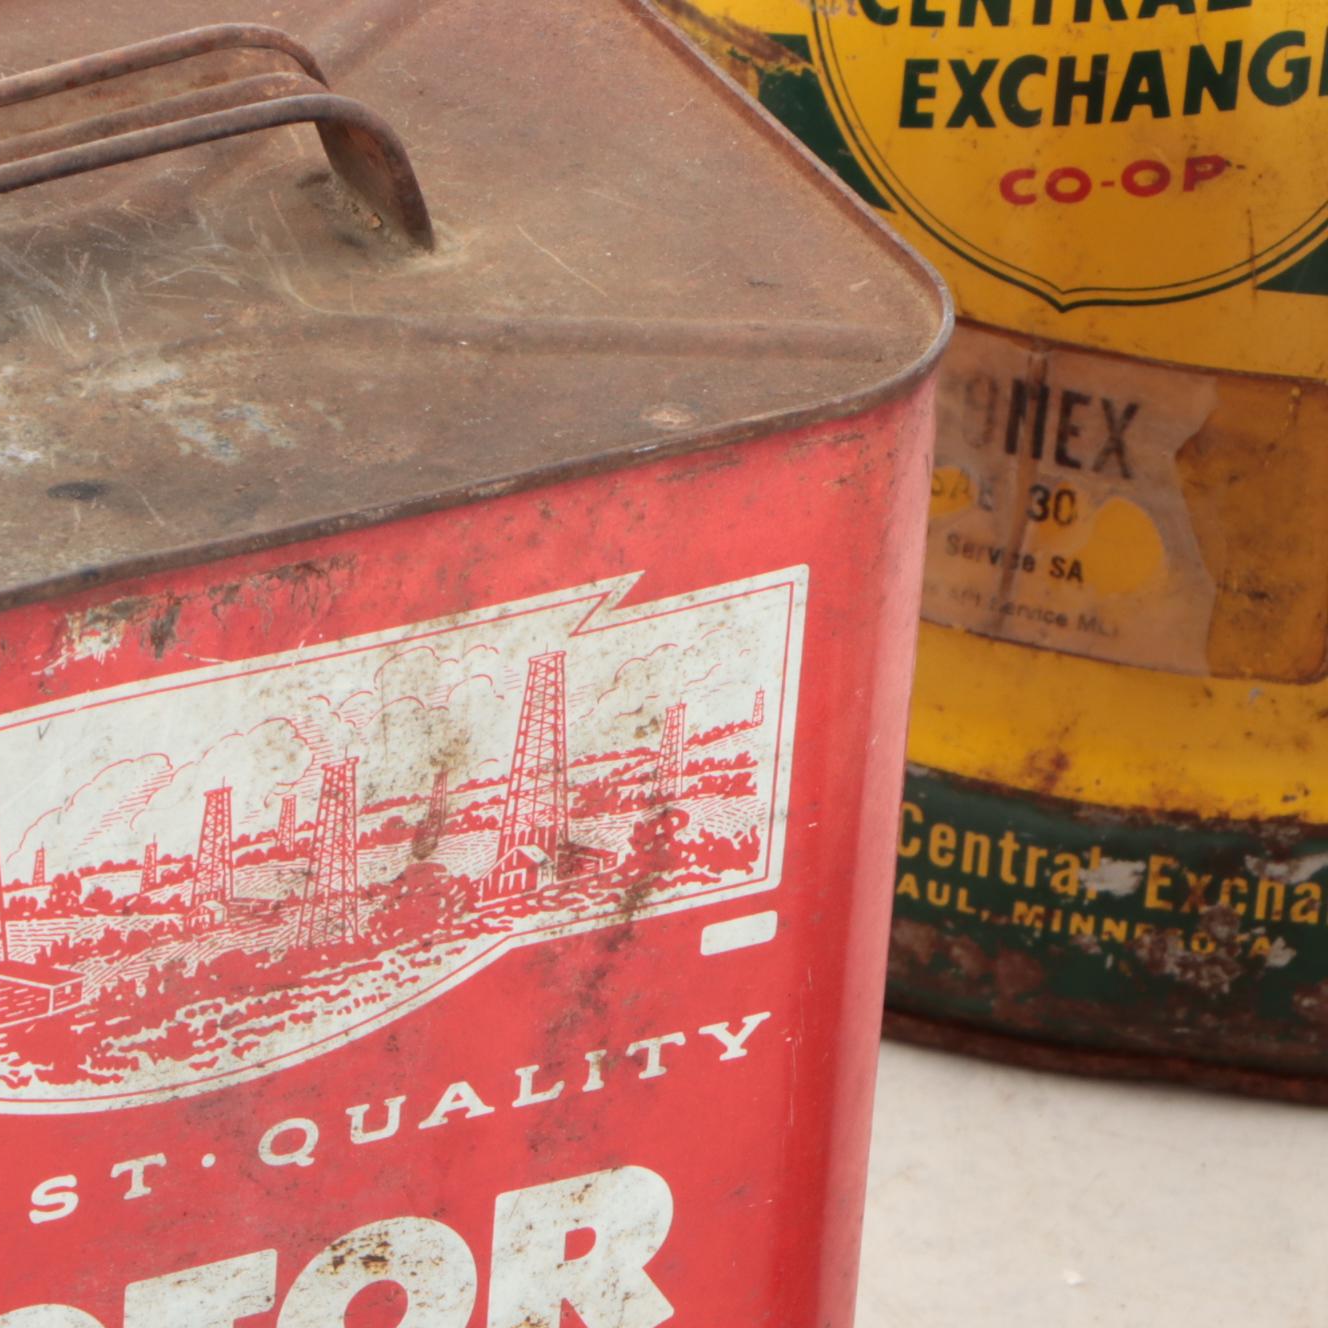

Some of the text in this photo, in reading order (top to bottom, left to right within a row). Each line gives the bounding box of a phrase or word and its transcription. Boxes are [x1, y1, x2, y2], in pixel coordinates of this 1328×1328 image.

[898, 30, 1328, 129] EXCHANG
[999, 154, 1229, 206] CO-OP
[1025, 482, 1077, 527] 30
[255, 1009, 773, 1170] QUALITY
